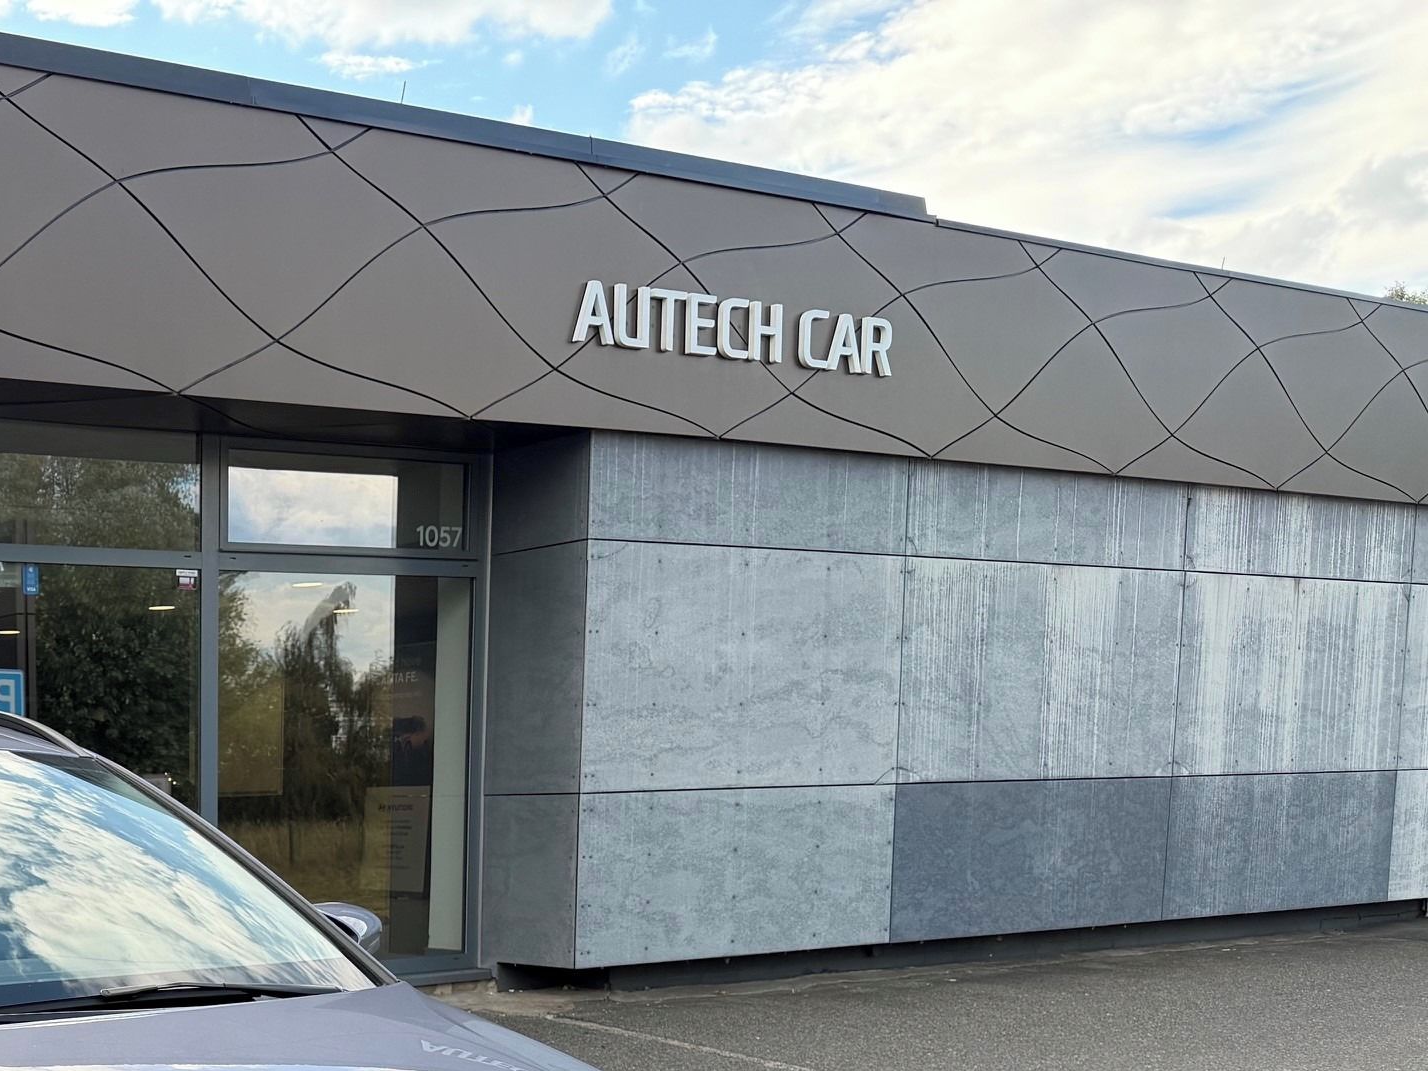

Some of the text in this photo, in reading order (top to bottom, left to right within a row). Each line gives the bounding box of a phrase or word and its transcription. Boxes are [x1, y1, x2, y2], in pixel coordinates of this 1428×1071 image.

[572, 279, 893, 377] AUTECH CAR
[416, 525, 462, 548] 1057
